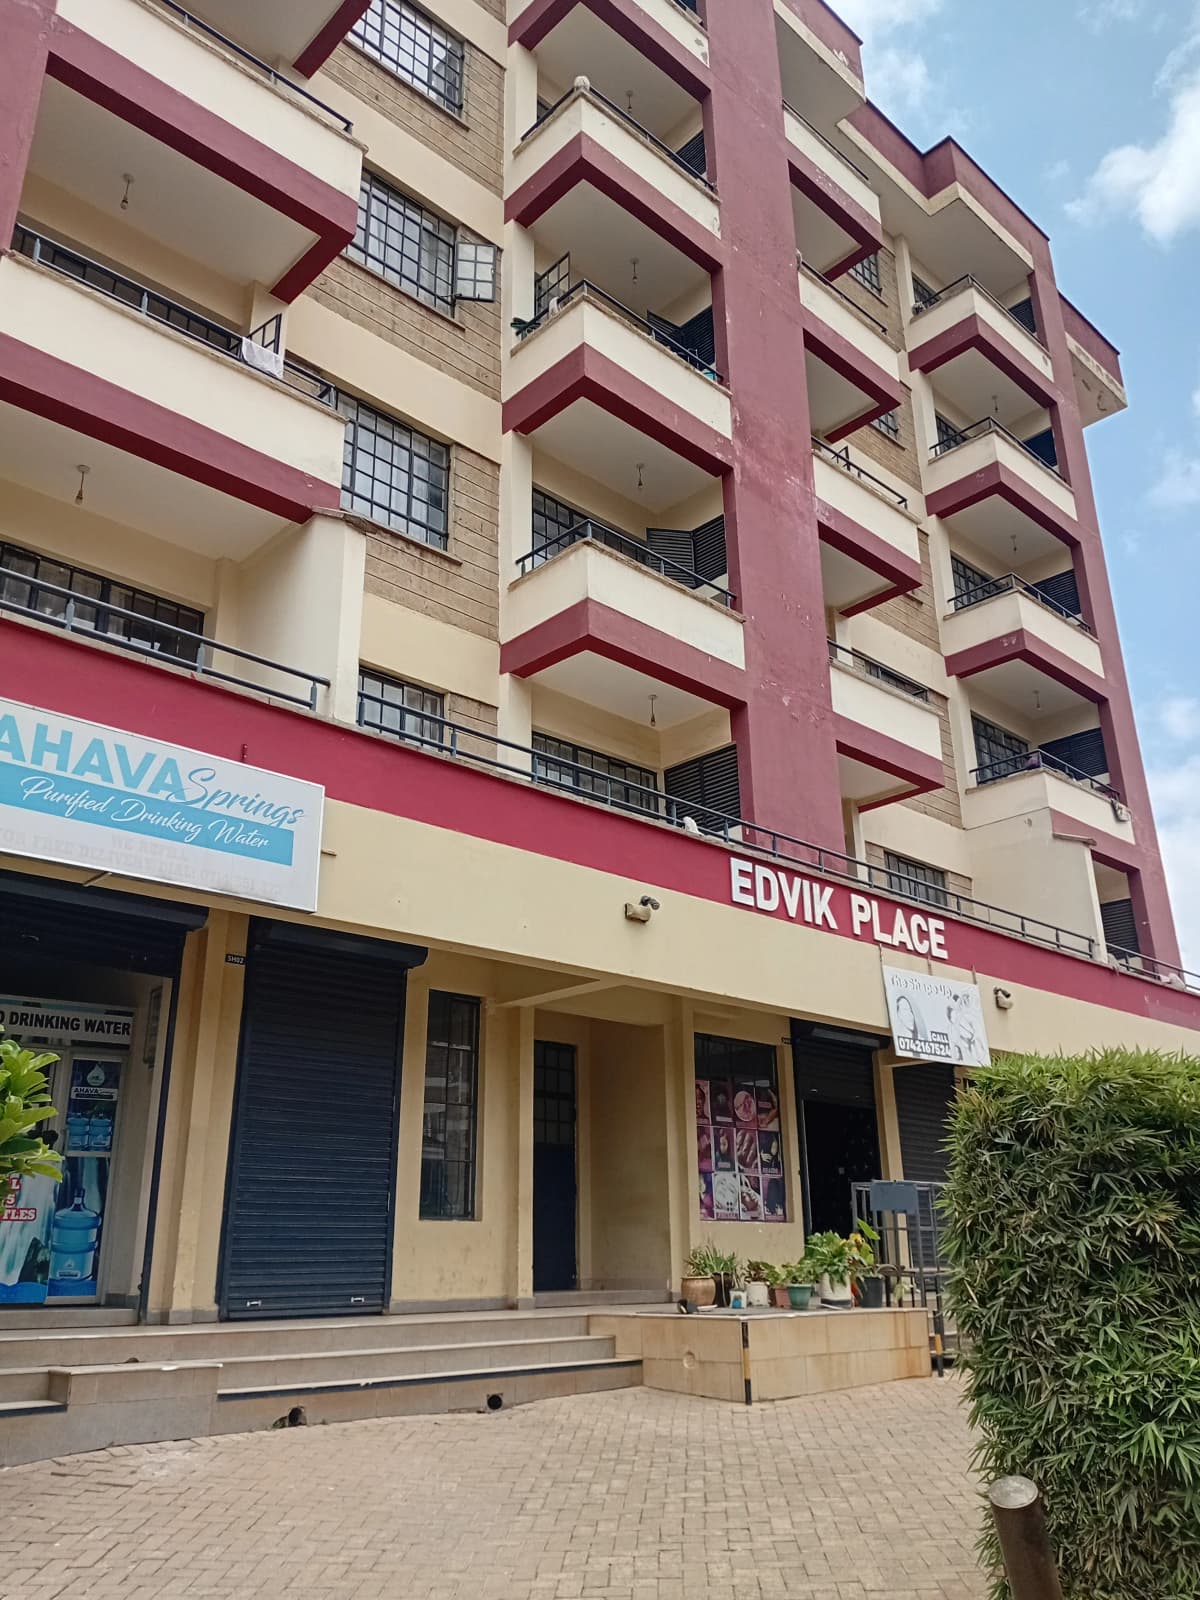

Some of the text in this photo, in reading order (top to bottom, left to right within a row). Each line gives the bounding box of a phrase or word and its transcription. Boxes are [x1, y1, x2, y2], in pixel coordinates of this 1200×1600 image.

[0, 714, 304, 829] AHAVA Springs
[20, 776, 270, 848] Purified Drinking Water
[730, 857, 949, 959] EDVIK PLACE
[9, 1011, 81, 1031] DRINKING
[84, 1018, 131, 1036] WATER
[931, 1032, 949, 1044] CALL
